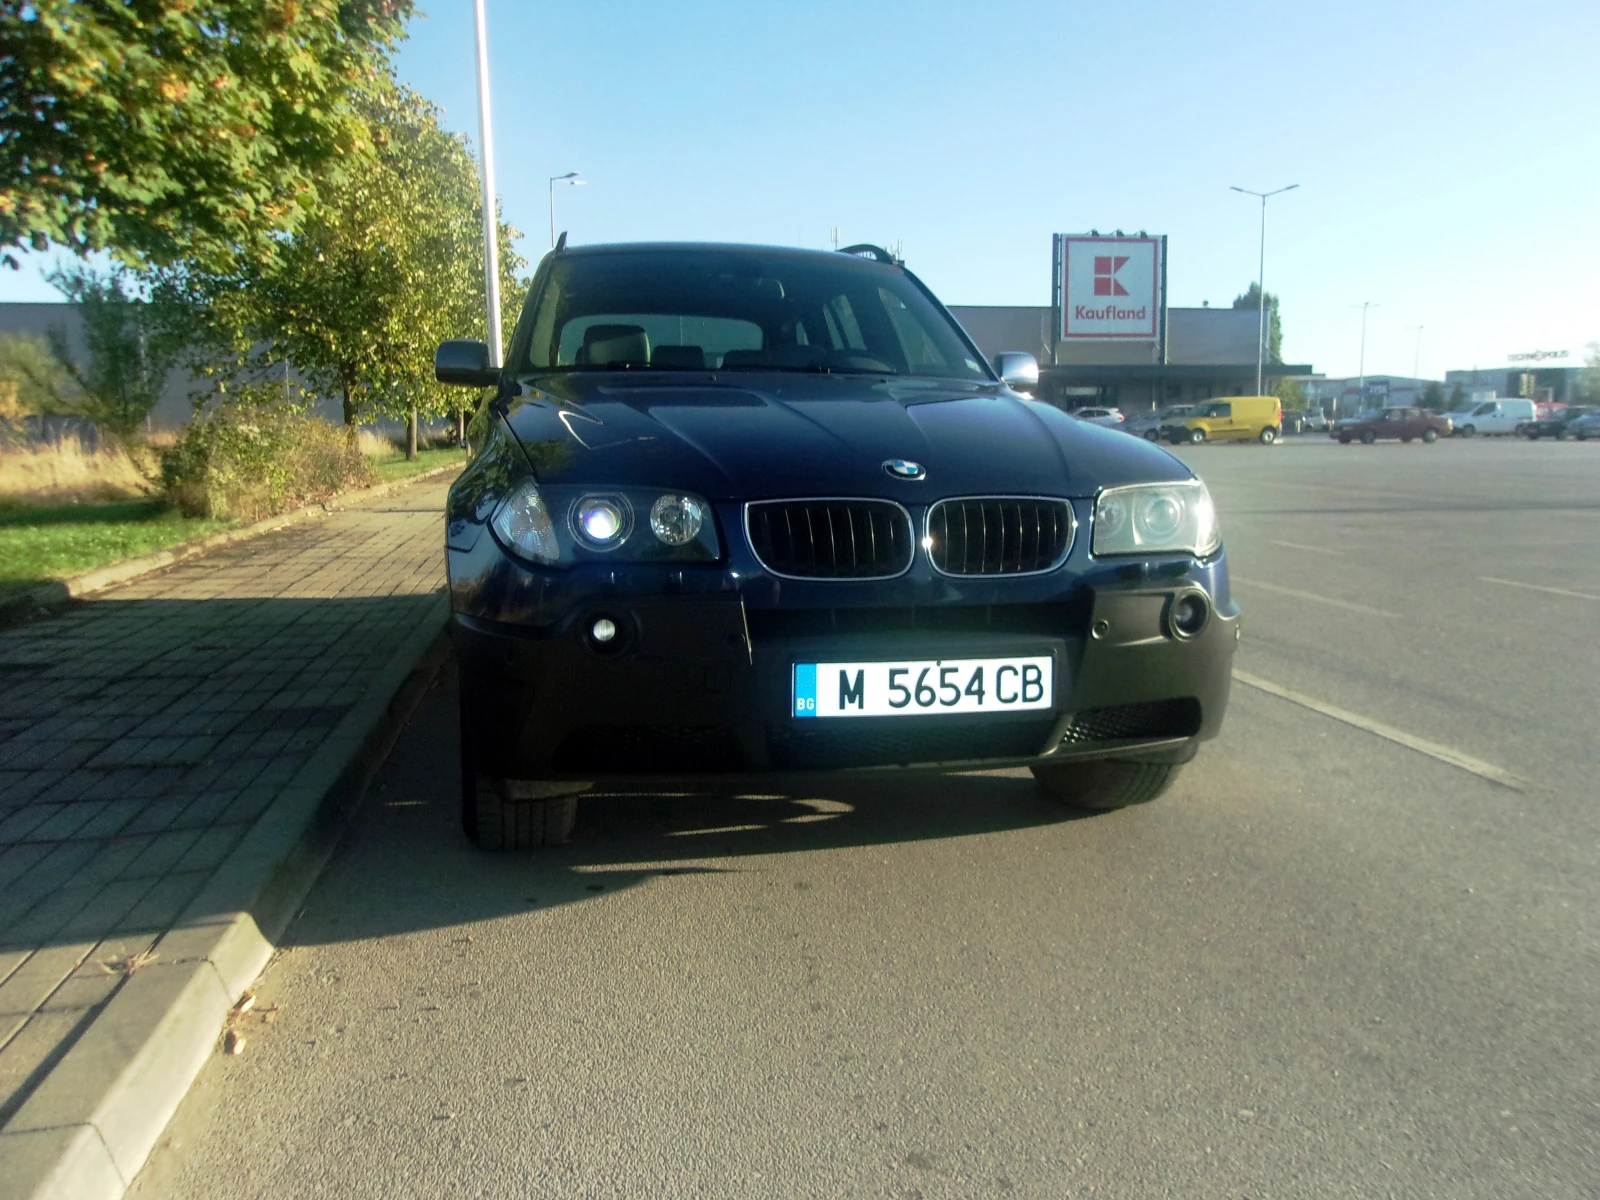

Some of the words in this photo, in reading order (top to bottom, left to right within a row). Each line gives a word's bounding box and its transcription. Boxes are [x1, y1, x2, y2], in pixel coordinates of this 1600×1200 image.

[1075, 305, 1146, 320] Kaufland
[839, 669, 864, 709] M
[888, 666, 985, 708] 5654
[996, 664, 1044, 704] CB
[797, 698, 815, 710] BG
